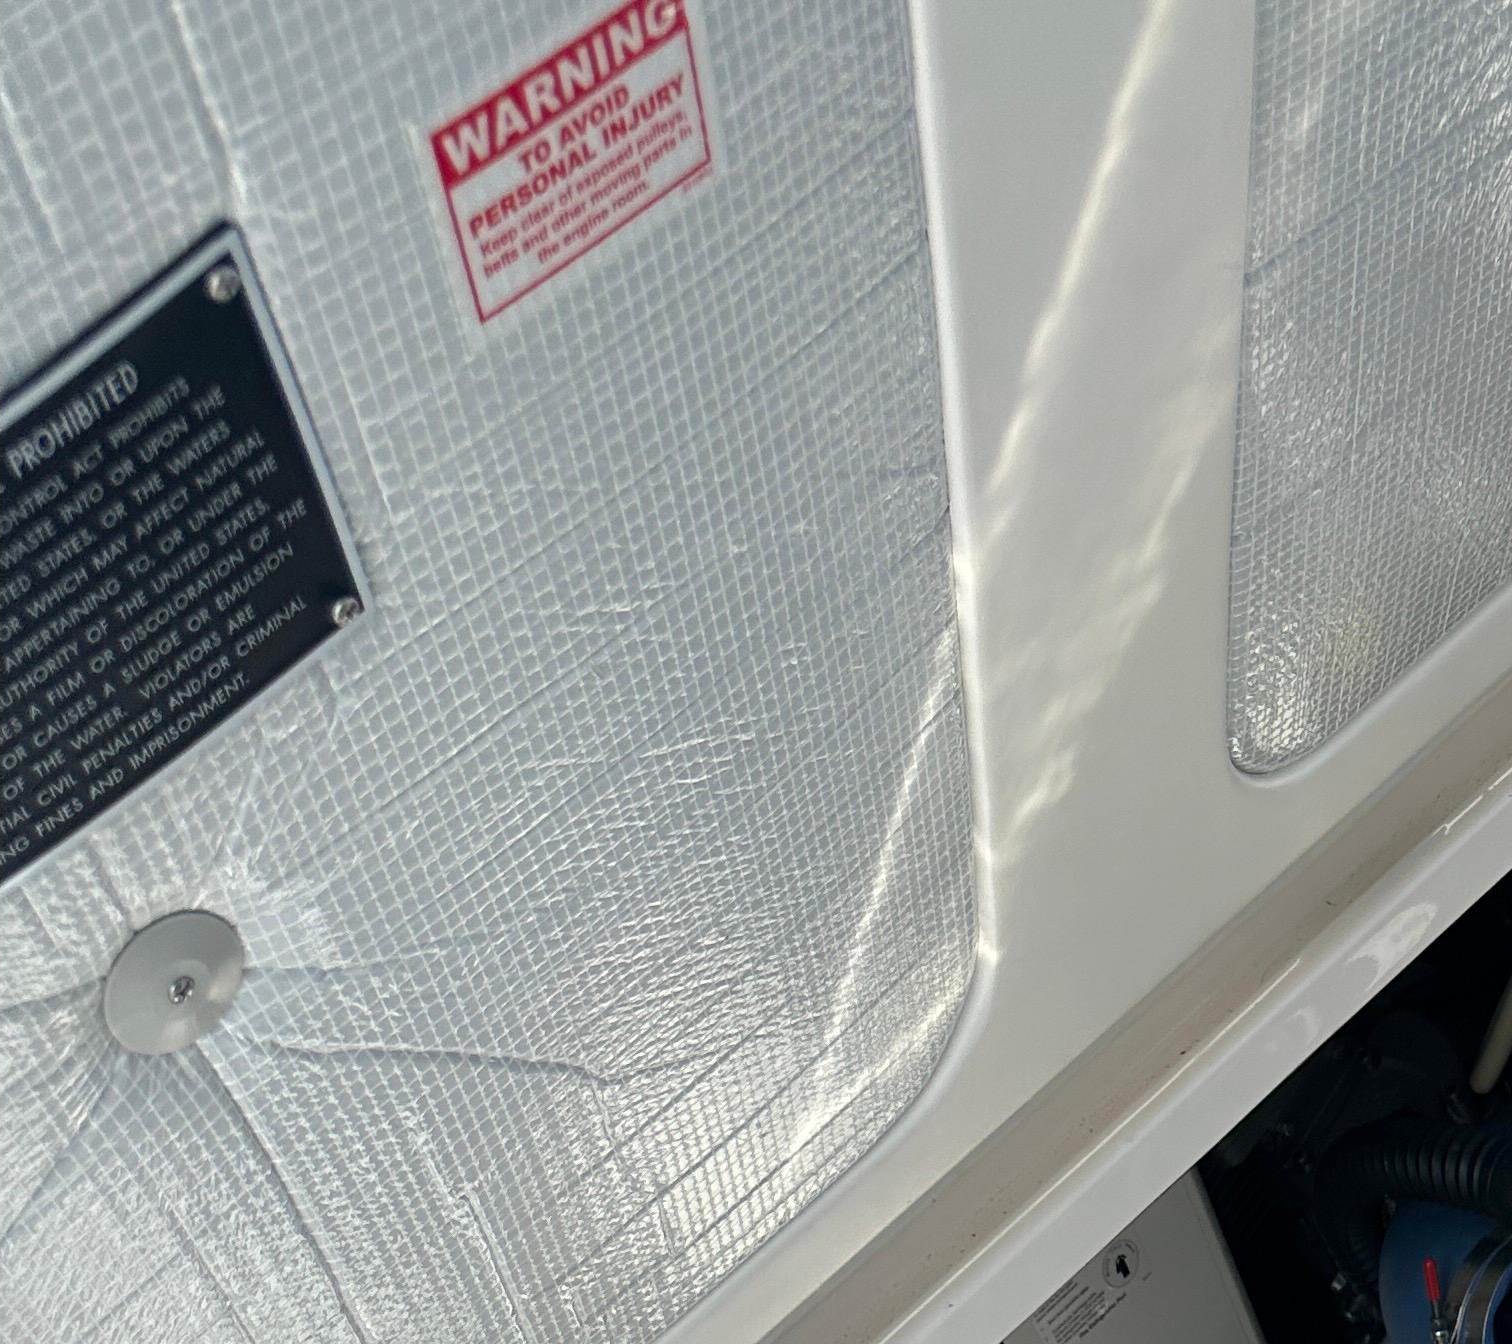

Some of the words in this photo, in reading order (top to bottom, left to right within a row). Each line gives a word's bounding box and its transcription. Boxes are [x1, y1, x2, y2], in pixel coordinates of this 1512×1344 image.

[443, 0, 675, 171] WARNING
[469, 143, 594, 235] PERSONAL
[602, 75, 681, 145] INJURY
[518, 139, 550, 171] TO
[559, 85, 628, 147] AVOID
[480, 227, 517, 257] Keep
[520, 201, 554, 230] clear
[558, 184, 572, 205] of
[575, 143, 633, 192] exposed
[483, 248, 518, 277] belts
[521, 225, 548, 252] and
[551, 201, 585, 230] other
[590, 162, 641, 205] moving
[642, 137, 676, 170] parts
[679, 125, 691, 140] in
[537, 242, 559, 262] the
[562, 208, 609, 245] engine
[0, 474, 68, 534] ONTROL
[72, 444, 102, 477] ACT
[108, 378, 189, 448] PROHIBITS
[0, 519, 56, 568] WASTE
[58, 482, 103, 523] INTO
[109, 458, 134, 485] OR
[138, 417, 188, 462] UPON
[193, 386, 224, 419] THE
[6, 364, 137, 476] PROHIBITED
[0, 575, 31, 606] TED
[100, 501, 127, 528] OR
[131, 473, 163, 503] THE
[167, 421, 229, 474] WATERS
[0, 616, 21, 642] OR
[25, 567, 88, 618] WHICH
[92, 536, 127, 570] MAY
[135, 487, 188, 539] AFFECT
[195, 431, 263, 489] NATURAL
[4, 578, 120, 672] APPERTAINING
[158, 527, 184, 554] OR
[187, 482, 241, 531] UNDER
[246, 454, 277, 484] THE
[0, 642, 77, 710] UTHORITY
[85, 618, 108, 643] OF
[115, 589, 147, 619] THE
[151, 542, 209, 593] UNITED
[0, 745, 27, 770] OR
[32, 694, 96, 747] CAUSES
[103, 682, 115, 697] A
[120, 630, 180, 683] SLUDGE
[186, 607, 210, 632] OR
[214, 542, 293, 611] EMULSION
[28, 704, 41, 720] A
[46, 671, 84, 705] FILM
[88, 648, 114, 673] OR
[119, 548, 243, 651] DISCOLORATION
[248, 525, 270, 551] OF
[276, 498, 306, 528] THE
[0, 806, 30, 833] TIAL
[36, 773, 76, 806] CIVIL
[81, 707, 162, 774] PENALTIES
[168, 655, 230, 710] AND/OR
[235, 596, 305, 656] CRIMINAL
[2, 776, 24, 800] OF
[32, 748, 65, 777] THE
[138, 631, 221, 698] VIOLATORS
[227, 604, 254, 635] ARE
[0, 836, 29, 864] NG
[35, 797, 83, 837] FINES
[89, 767, 123, 800] AND
